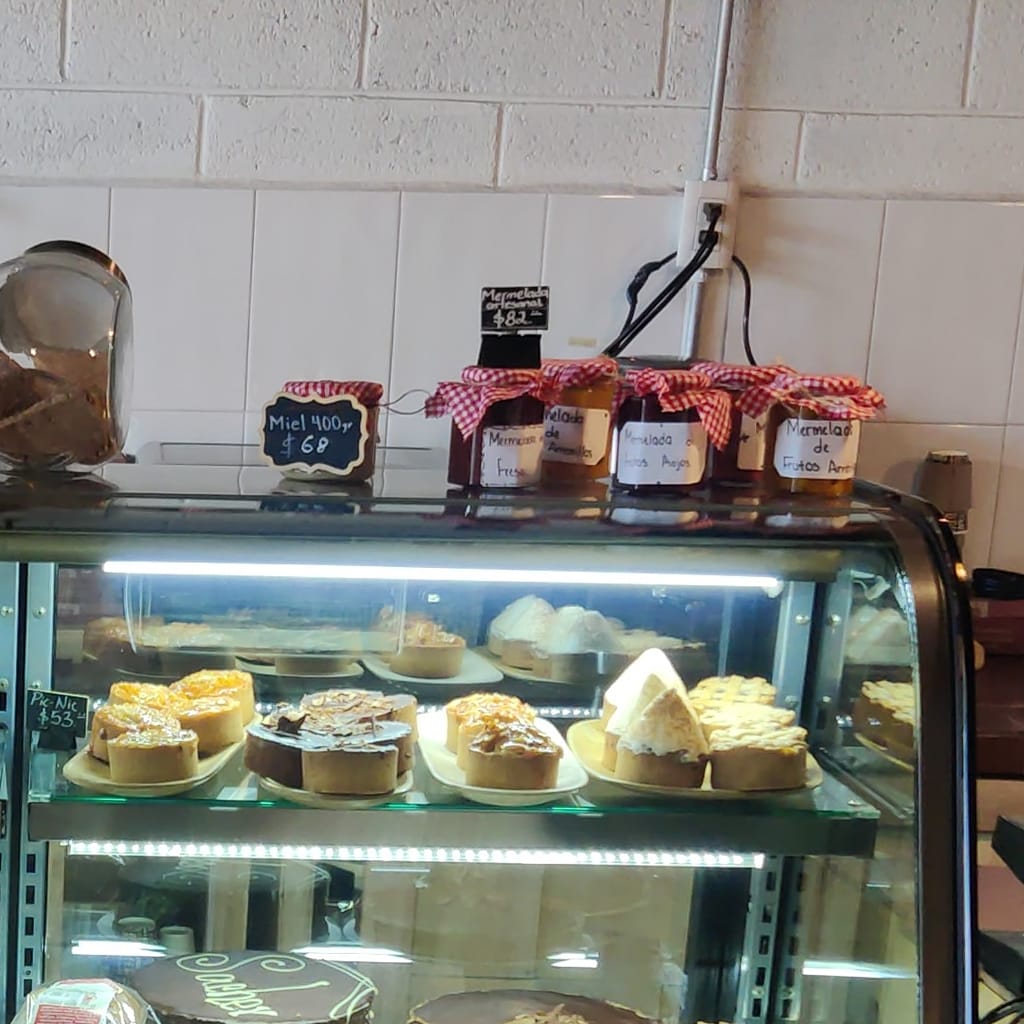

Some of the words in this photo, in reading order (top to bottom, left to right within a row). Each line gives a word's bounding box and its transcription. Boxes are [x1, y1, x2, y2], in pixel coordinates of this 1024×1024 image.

[481, 288, 548, 301] Mermelada
[269, 413, 306, 431] Miel
[545, 427, 560, 439] de
[813, 438, 830, 453] de
[783, 456, 820, 472] Frutos
